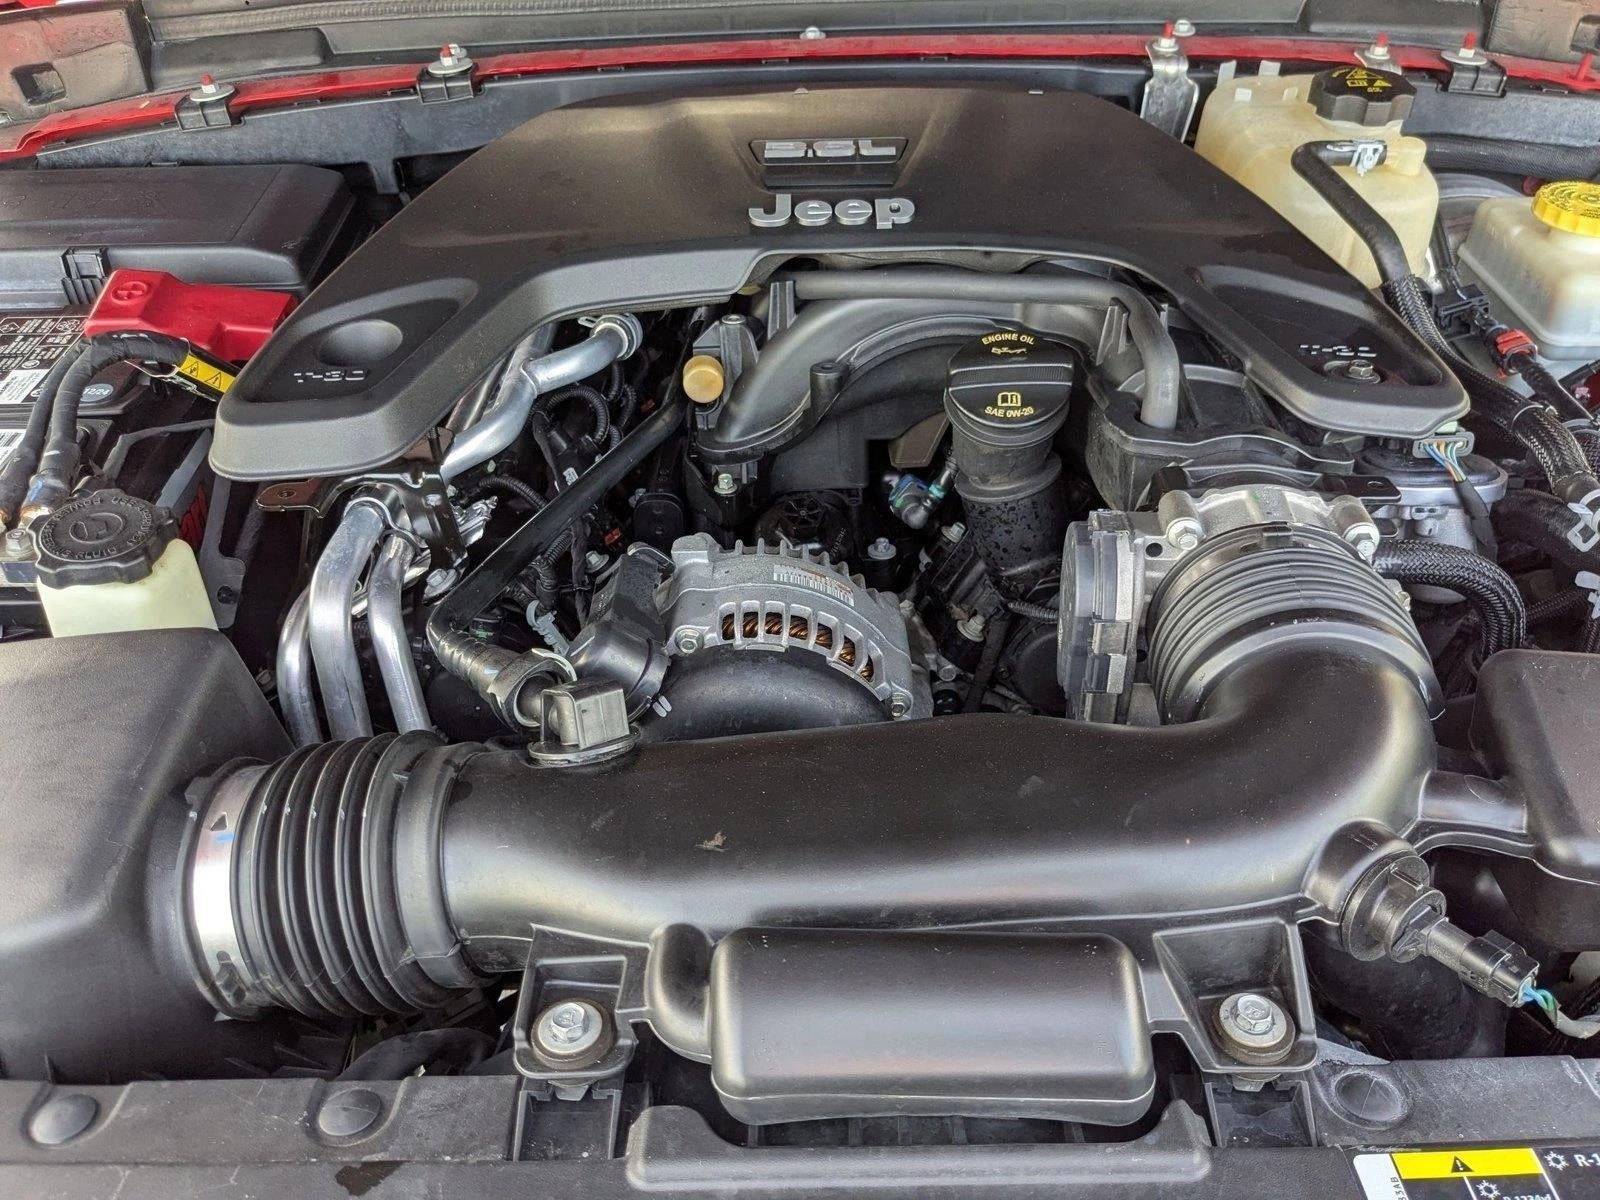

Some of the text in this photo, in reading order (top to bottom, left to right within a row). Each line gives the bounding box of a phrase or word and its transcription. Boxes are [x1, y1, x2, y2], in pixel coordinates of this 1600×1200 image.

[749, 194, 915, 230] Jeep
[981, 333, 1035, 345] ENGINE OIL
[984, 406, 1034, 418] SAE 0W-20
